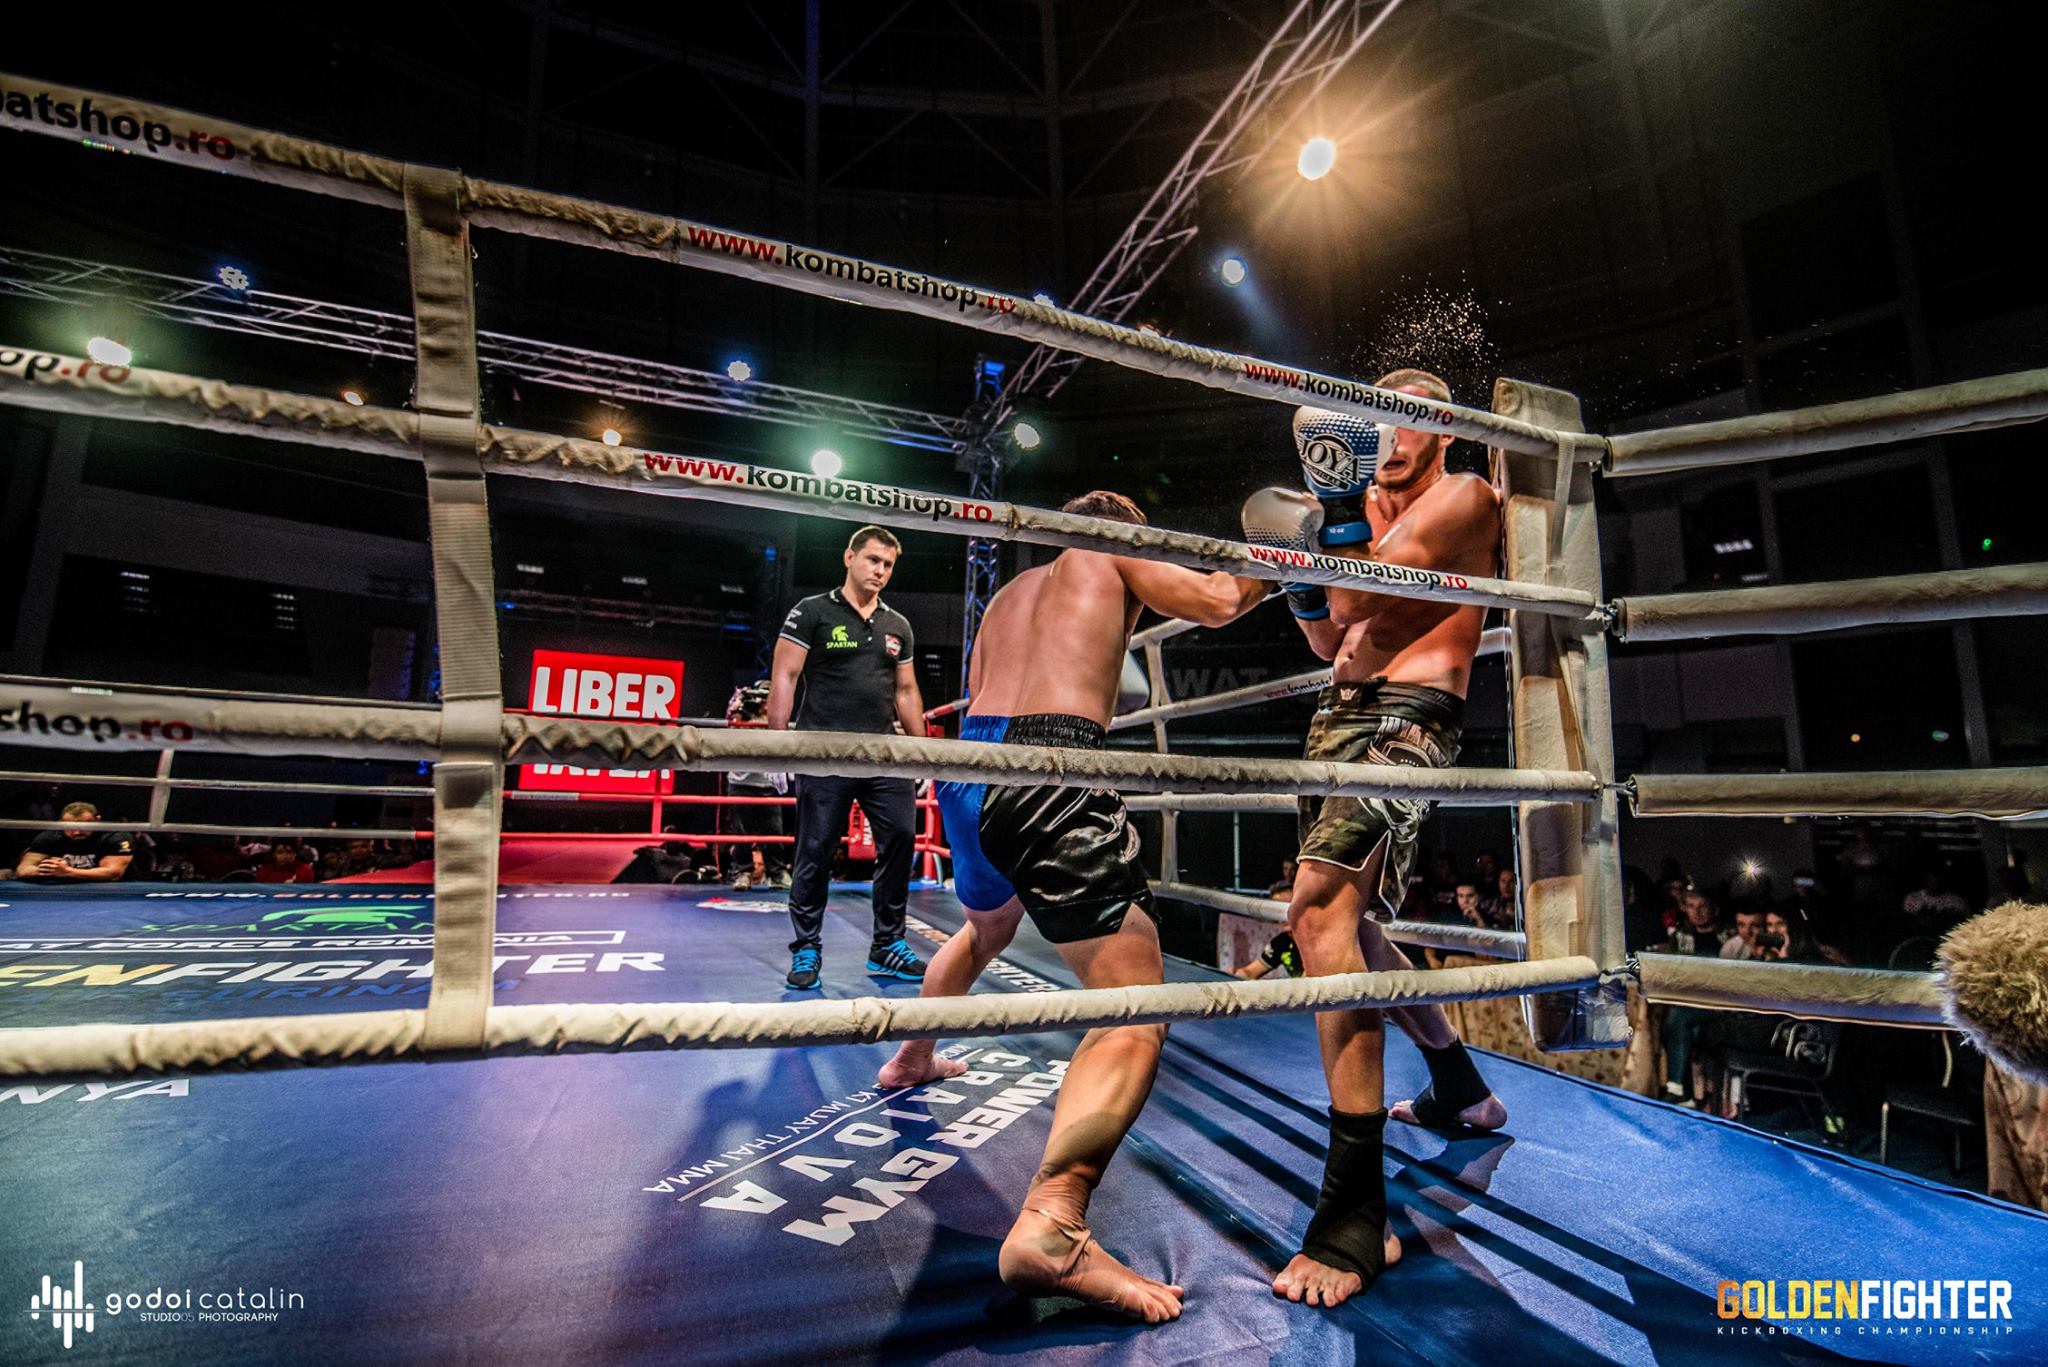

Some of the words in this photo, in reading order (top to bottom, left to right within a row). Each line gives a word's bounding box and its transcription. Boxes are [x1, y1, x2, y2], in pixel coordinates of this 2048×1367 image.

[0, 90, 235, 161] atshop.ro
[688, 226, 1017, 313] www.kombatshop.ro
[1244, 363, 1454, 425] www.kombatshop.ro
[1300, 438, 1360, 486] JOYA
[644, 452, 993, 523] www.kombatshop.ro
[1248, 546, 1468, 590] www.kombatshop.ro
[826, 641, 858, 649] SPARTAN
[532, 666, 676, 719] LIBER
[312, 934, 573, 947] ROMNIA
[699, 1052, 1031, 1214] CRAIOVA
[784, 1100, 851, 1135] MUAY
[719, 1131, 792, 1161] THAI
[642, 1159, 728, 1193] MMA
[782, 1148, 959, 1246] GYM
